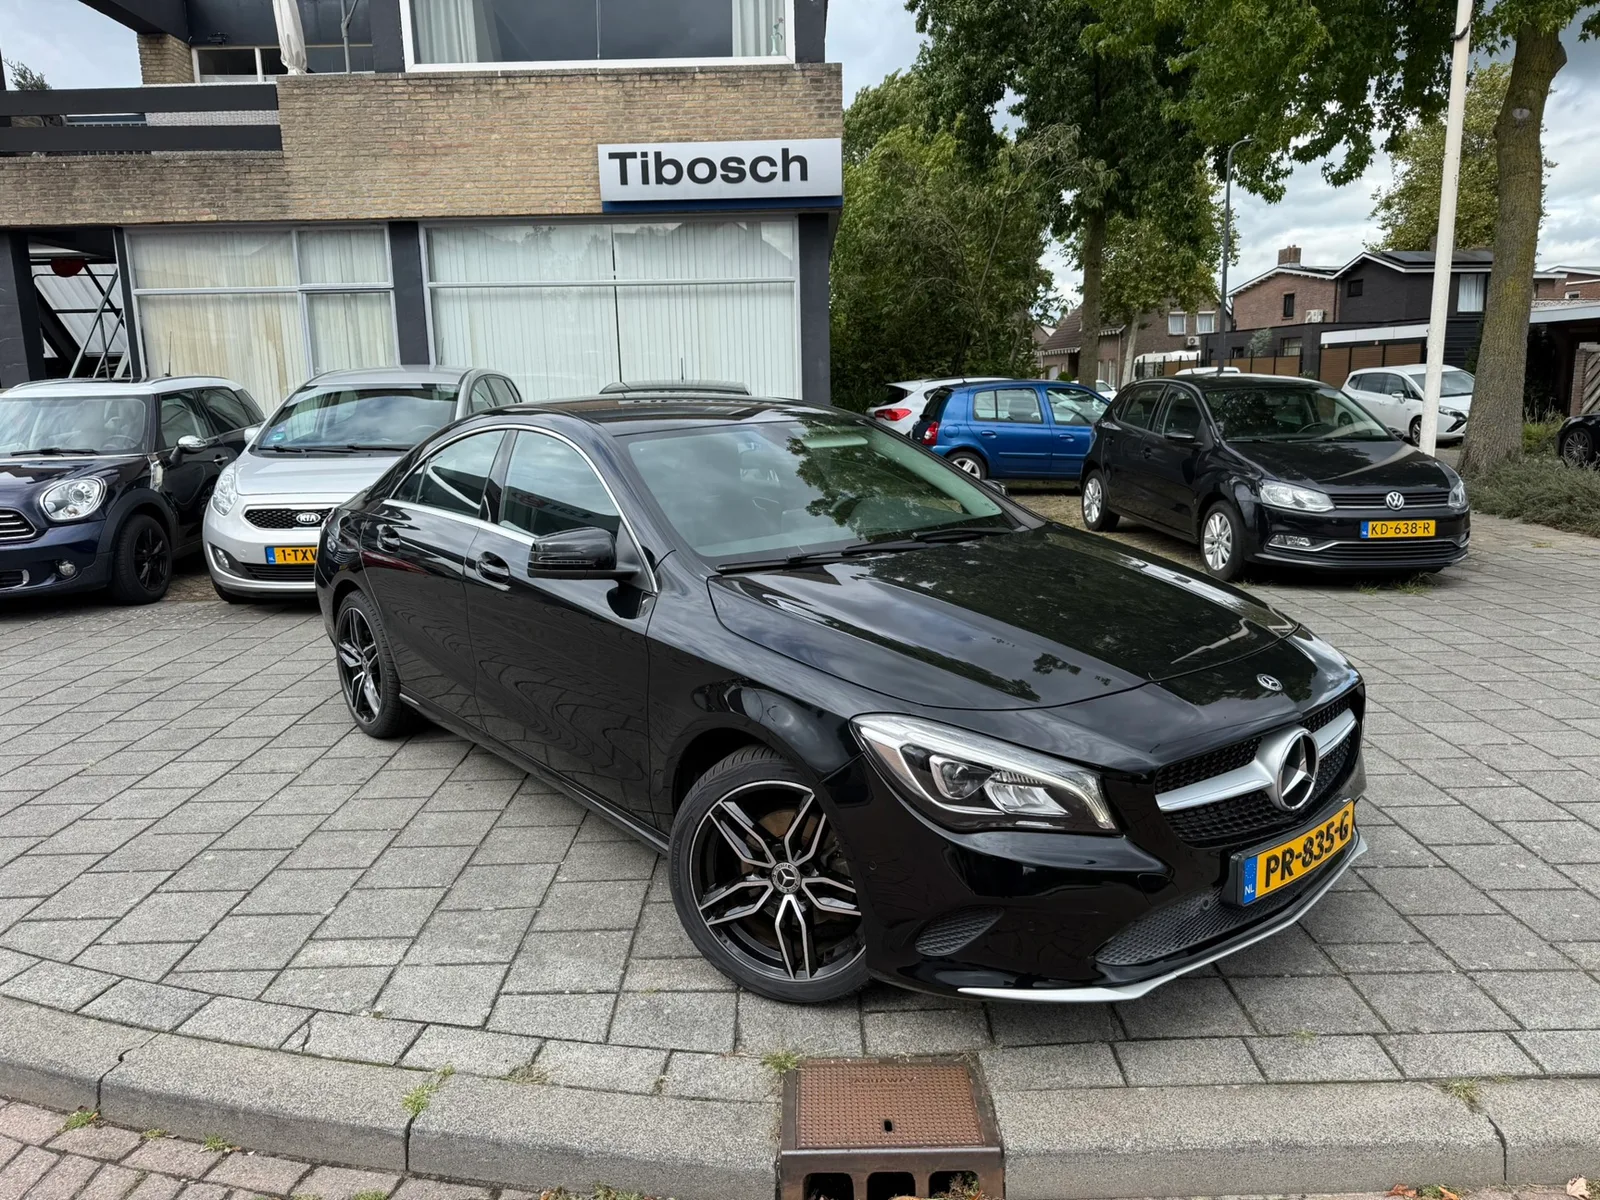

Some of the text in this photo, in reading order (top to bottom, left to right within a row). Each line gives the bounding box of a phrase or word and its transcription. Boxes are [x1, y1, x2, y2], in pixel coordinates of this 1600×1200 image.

[608, 148, 808, 186] Tibosch
[300, 514, 316, 522] KIA
[1371, 522, 1431, 536] KD-638-R
[1244, 810, 1350, 896] NL PR-835-G
[853, 1077, 916, 1085] AQUAWAY
